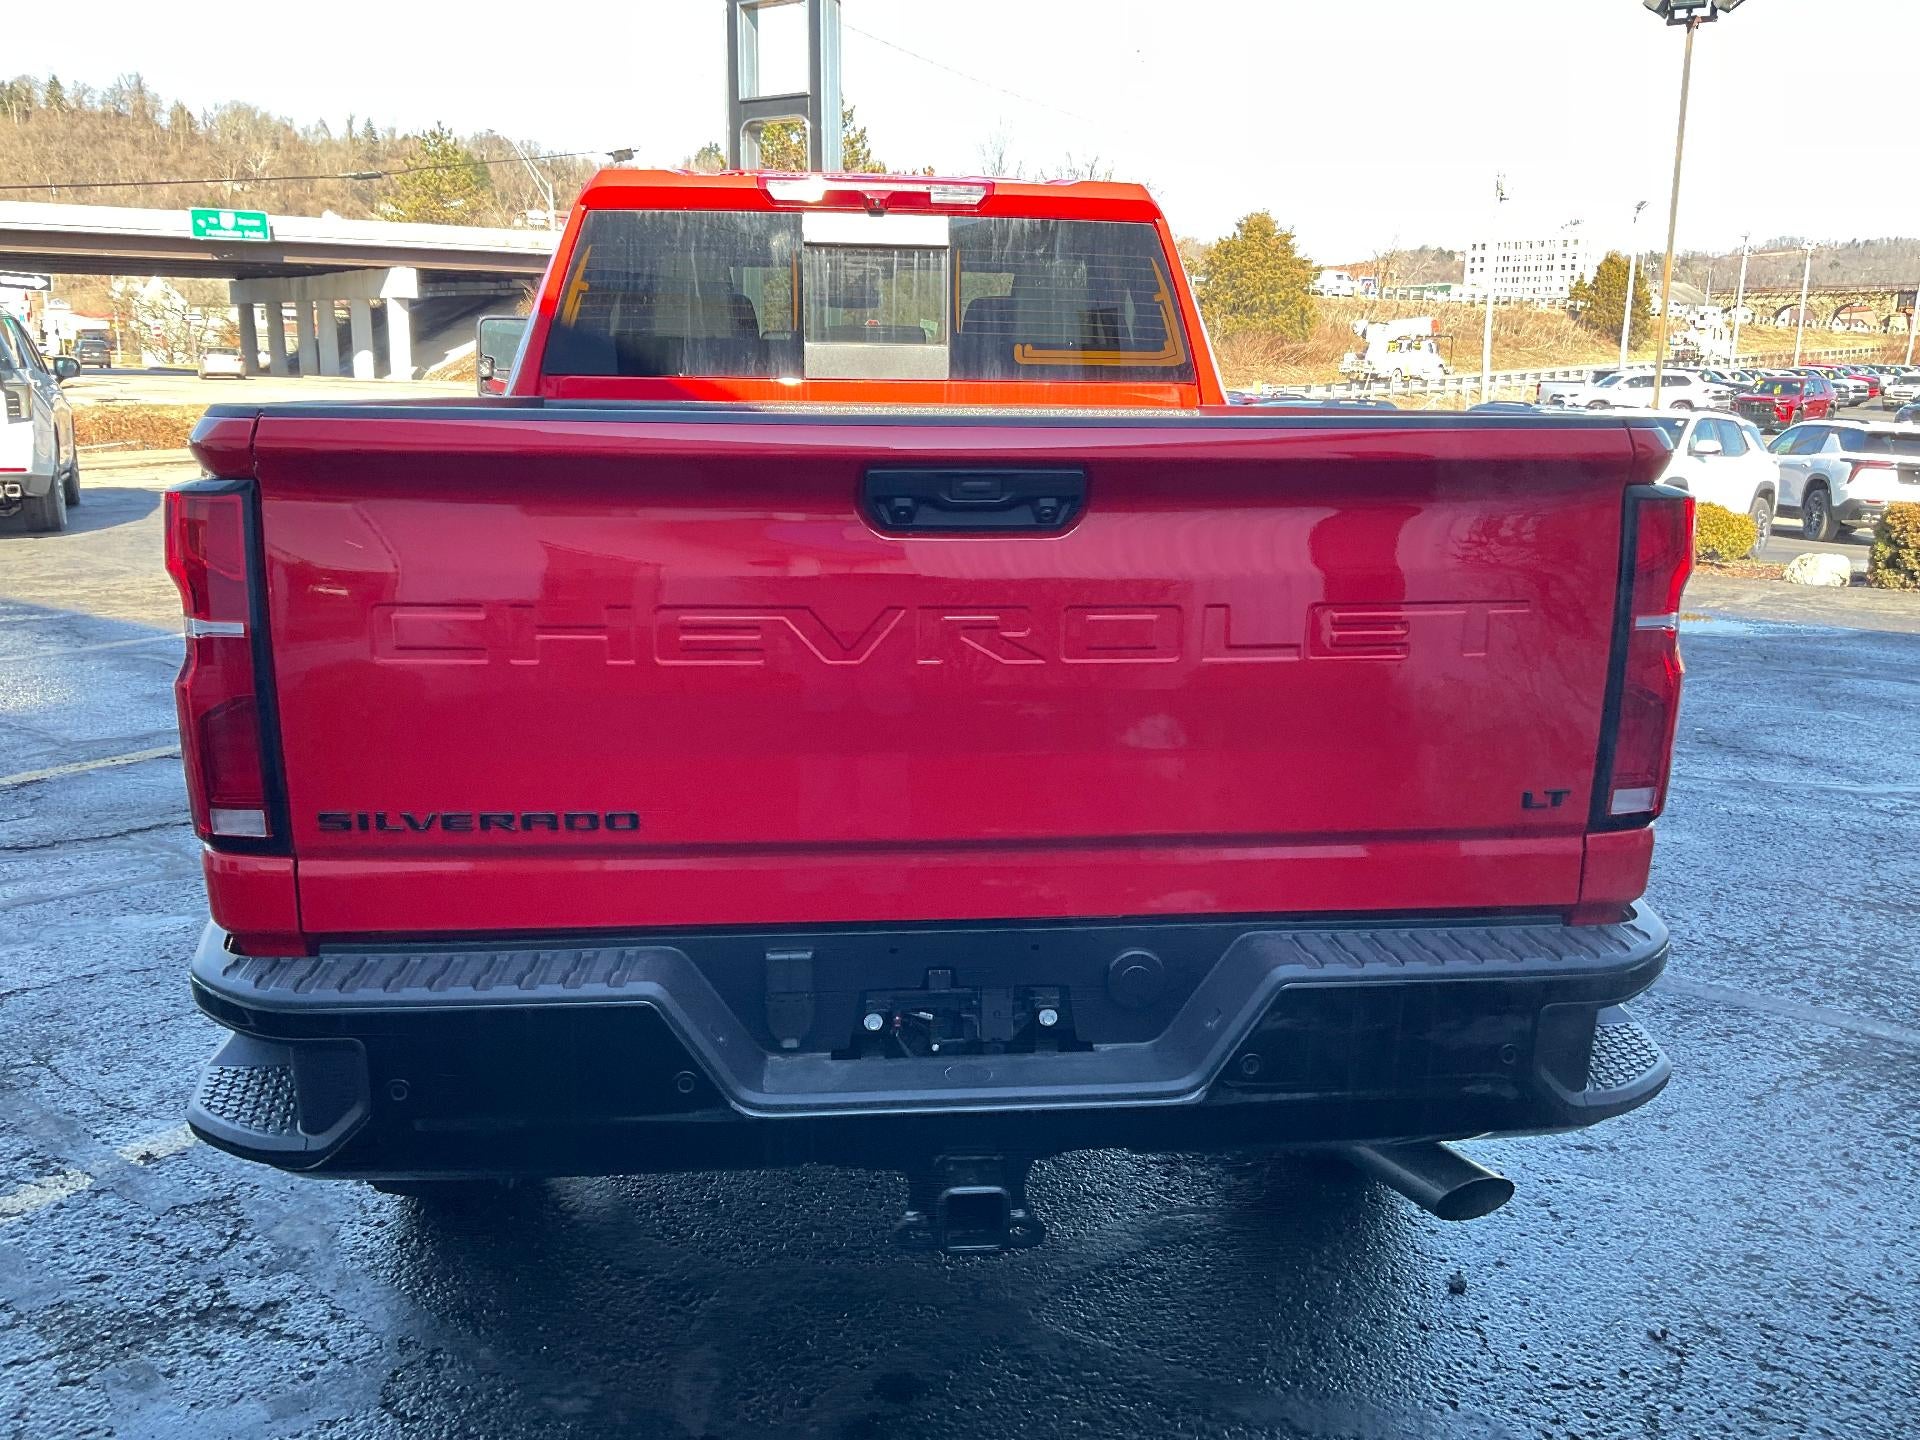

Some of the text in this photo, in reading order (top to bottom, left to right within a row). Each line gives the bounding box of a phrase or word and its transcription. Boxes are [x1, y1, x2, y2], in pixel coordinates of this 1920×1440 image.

[370, 600, 1531, 666] CHEVROLET
[1520, 788, 1572, 809] LT
[317, 810, 643, 832] SILVERADO
